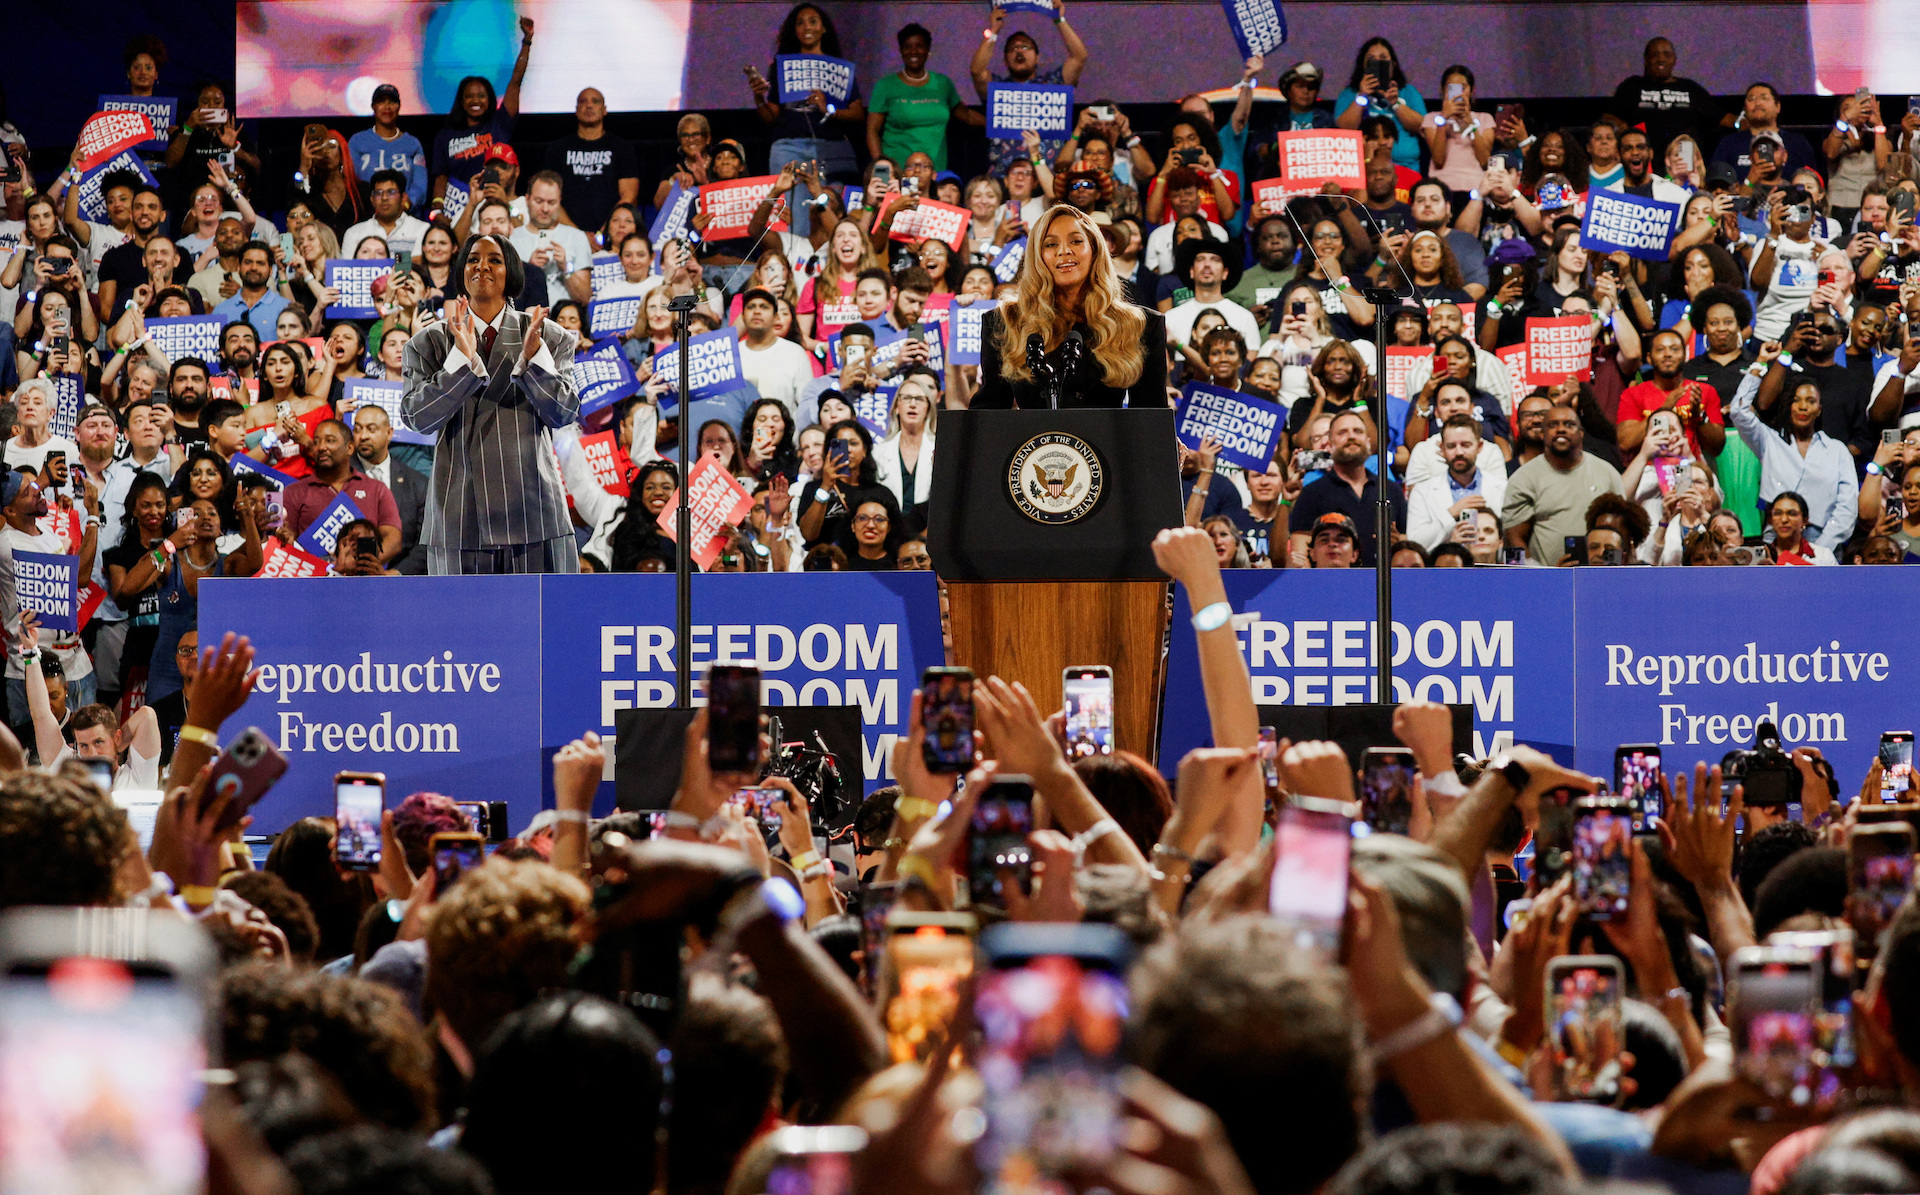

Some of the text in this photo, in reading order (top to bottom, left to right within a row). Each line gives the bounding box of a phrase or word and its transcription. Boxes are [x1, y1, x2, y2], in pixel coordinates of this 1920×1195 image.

[783, 59, 849, 77] FREEDOM
[784, 69, 849, 89] FREEDOM
[785, 79, 846, 101] FREEDOM
[994, 90, 1067, 105] FREEDOM
[993, 103, 1066, 118] FREEDOM
[992, 116, 1065, 131] FREEDOM
[1286, 137, 1357, 153] FREEDOM
[566, 150, 612, 165] HARRIS
[1287, 149, 1358, 166] FREEDOM
[572, 163, 603, 176] WALZ
[1288, 164, 1360, 180] FREEDOM
[1592, 195, 1673, 224] FREEDOM
[1589, 210, 1670, 237] FREEDOM
[1587, 224, 1666, 251] FREEDOM
[333, 266, 393, 280] FREEDO
[333, 280, 371, 294] FREE
[593, 300, 640, 314] FREED
[591, 309, 638, 323] FREED
[149, 322, 220, 339] FREEDOM
[590, 319, 637, 335] FREED
[1190, 390, 1278, 430] FREEDOM
[1185, 405, 1273, 444] FREEDOM
[1011, 435, 1100, 519] VICE PRESIDENT OF THE UNITED STATES
[1605, 640, 1889, 695] Reproductive
[277, 711, 460, 752] Freedom
[1658, 702, 1848, 746] Freedom
